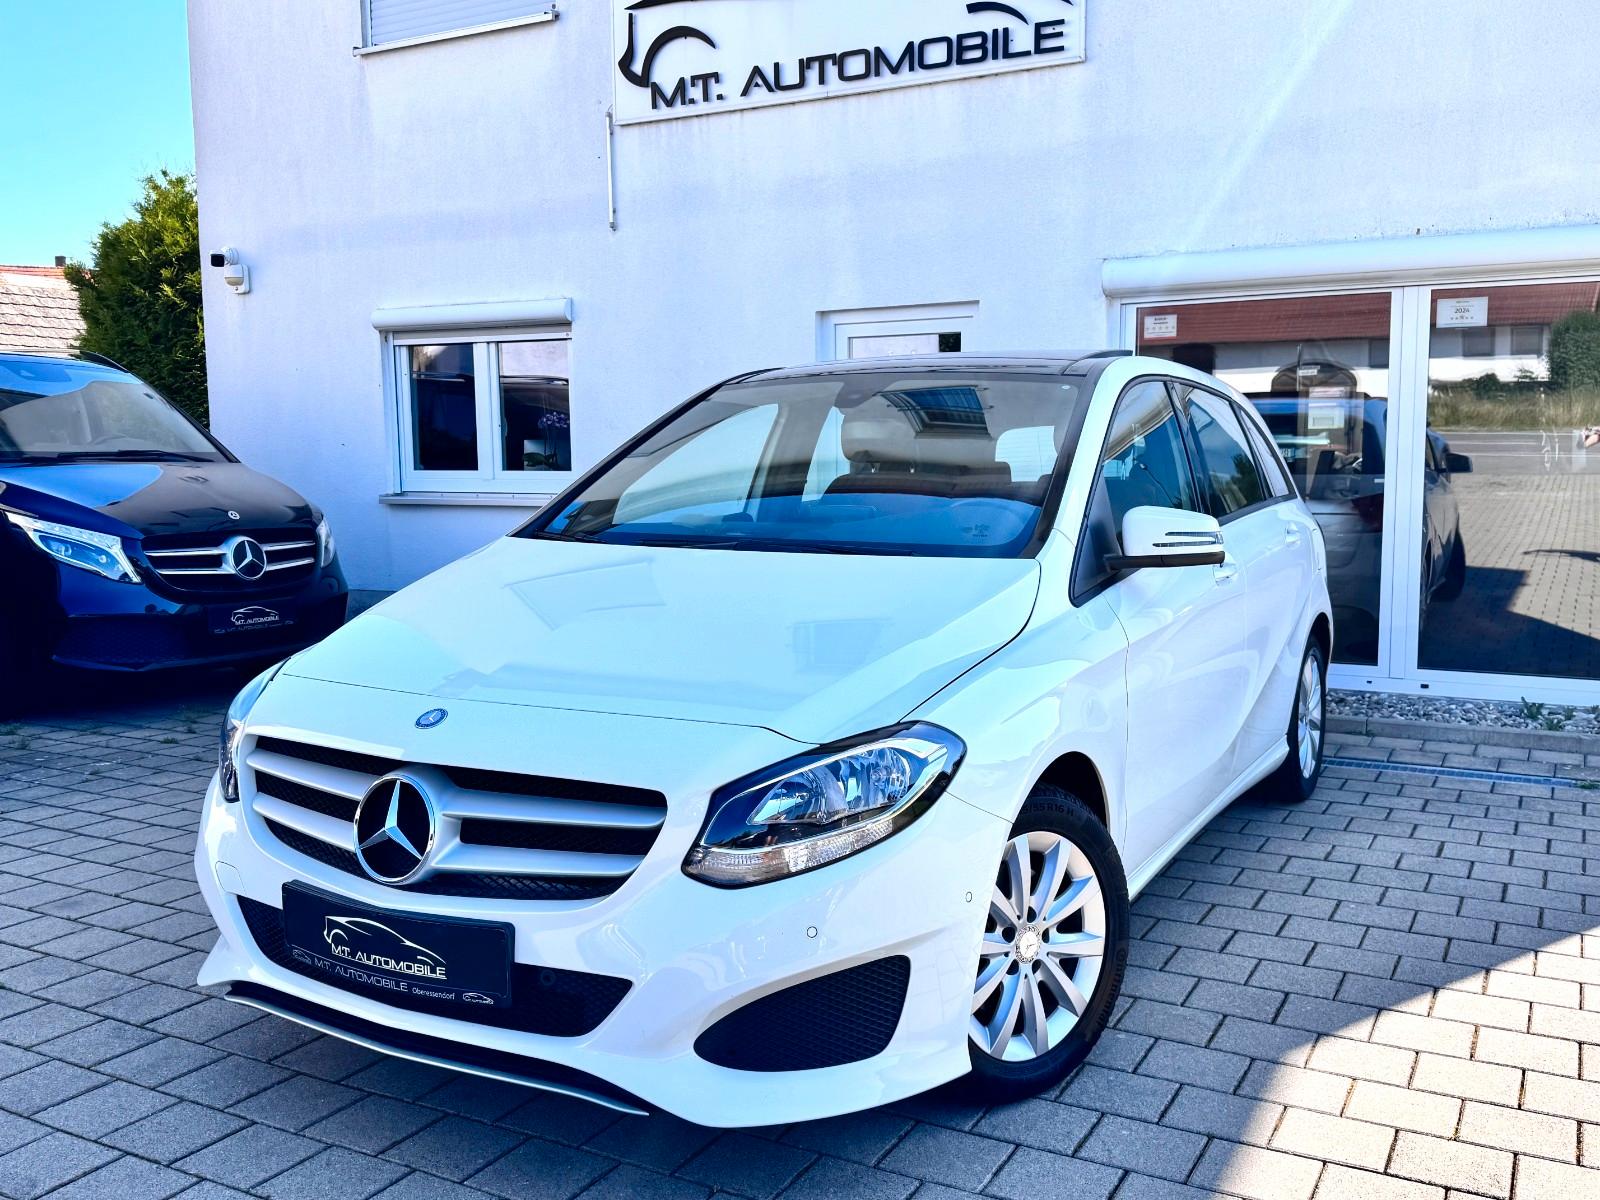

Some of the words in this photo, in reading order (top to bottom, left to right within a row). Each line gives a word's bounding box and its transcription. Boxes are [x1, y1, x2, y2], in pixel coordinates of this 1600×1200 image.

[650, 71, 724, 110] M.T.
[740, 18, 1066, 98] AUTOMOBILE
[314, 958, 332, 971] M.T.
[335, 966, 409, 992] AUTOMOBILE
[412, 986, 455, 1000] Oberessendorf
[331, 943, 351, 959] M.T.
[355, 951, 447, 978] AUTOMOBILE
